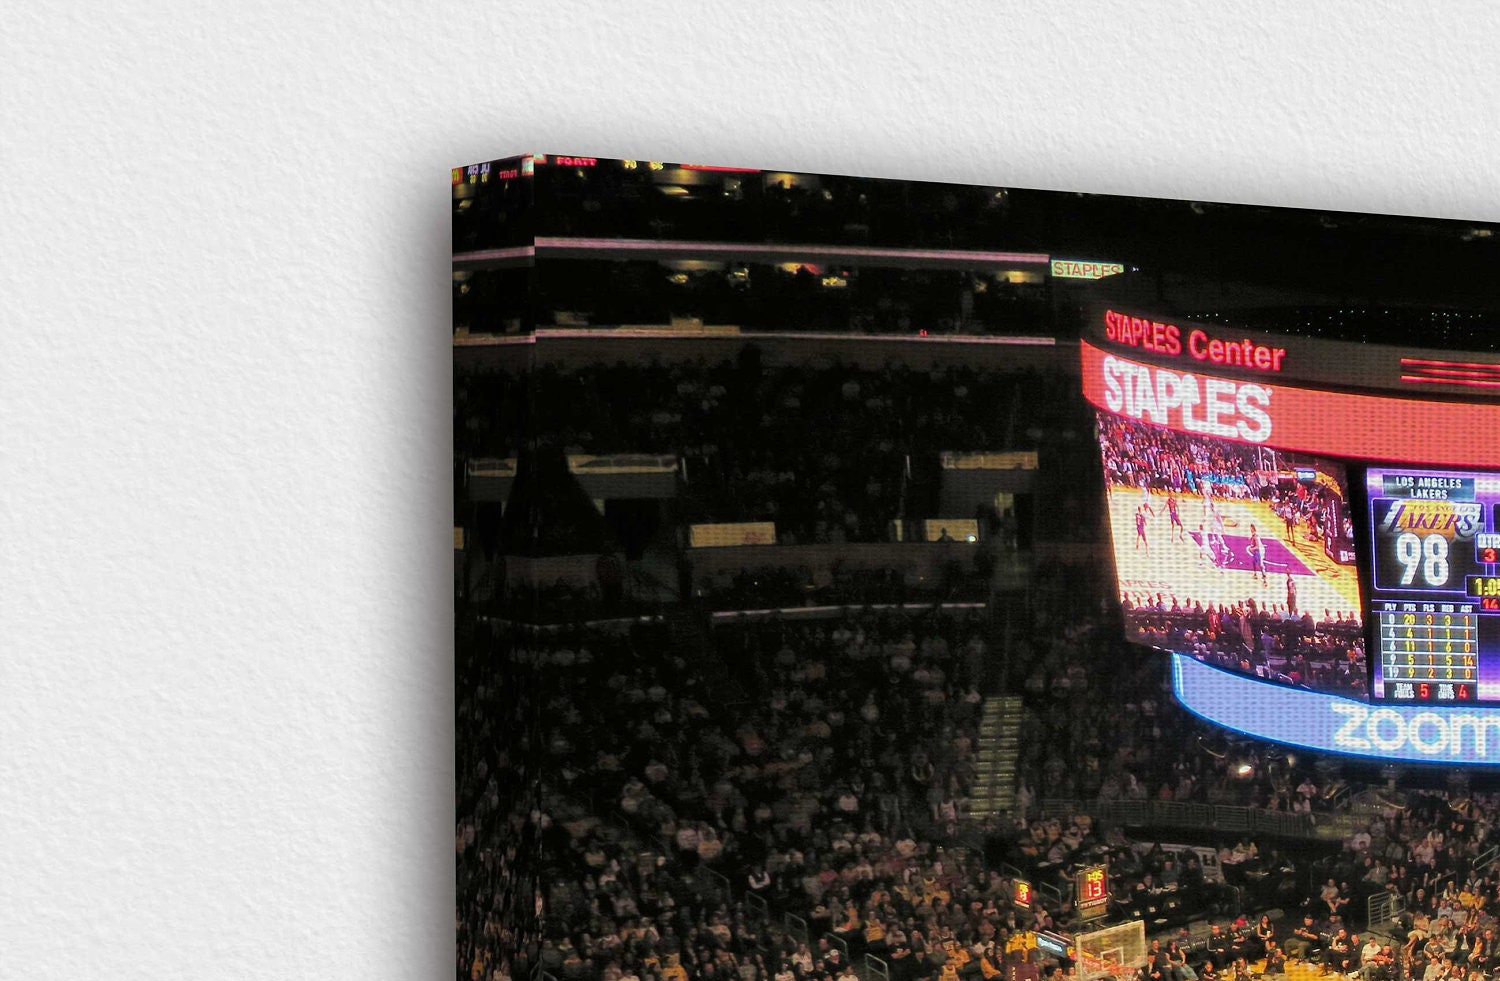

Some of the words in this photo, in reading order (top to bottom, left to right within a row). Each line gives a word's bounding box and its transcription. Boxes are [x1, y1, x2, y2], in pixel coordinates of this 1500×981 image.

[1105, 309, 1181, 356] STAPLES
[1189, 330, 1287, 371] Center
[1103, 355, 1273, 442] STAPLES
[1396, 477, 1415, 488] LOS
[1418, 478, 1462, 489] ANGELES
[1410, 488, 1448, 500] LAKERS
[1391, 503, 1478, 534] LAKERS
[1396, 532, 1449, 586] 98
[1483, 548, 1498, 563] 3
[1423, 604, 1435, 612] FLS
[1460, 605, 1472, 613] AST
[1482, 598, 1499, 610] 14
[1404, 614, 1416, 625] 20
[1426, 615, 1434, 625] 3
[1445, 615, 1452, 626] 3
[1464, 616, 1470, 626] 1
[1389, 628, 1395, 638] 4
[1406, 628, 1413, 638] 4
[1427, 628, 1432, 639] 1
[1446, 629, 1451, 639] 1
[1464, 629, 1470, 639] 1
[1406, 641, 1415, 651] 11
[1428, 642, 1433, 652] 1
[1464, 642, 1471, 652] 0
[1408, 655, 1415, 665] 5
[1428, 655, 1433, 665] 1
[1446, 656, 1452, 666] 5
[1463, 656, 1474, 666] 14
[1389, 667, 1399, 678] 19
[1408, 668, 1415, 678] 9
[1428, 669, 1435, 678] 2
[1446, 669, 1453, 679] 3
[1465, 669, 1472, 679] 0
[1420, 684, 1430, 698] 5
[1458, 685, 1469, 698] 4
[1087, 880, 1102, 897] 13
